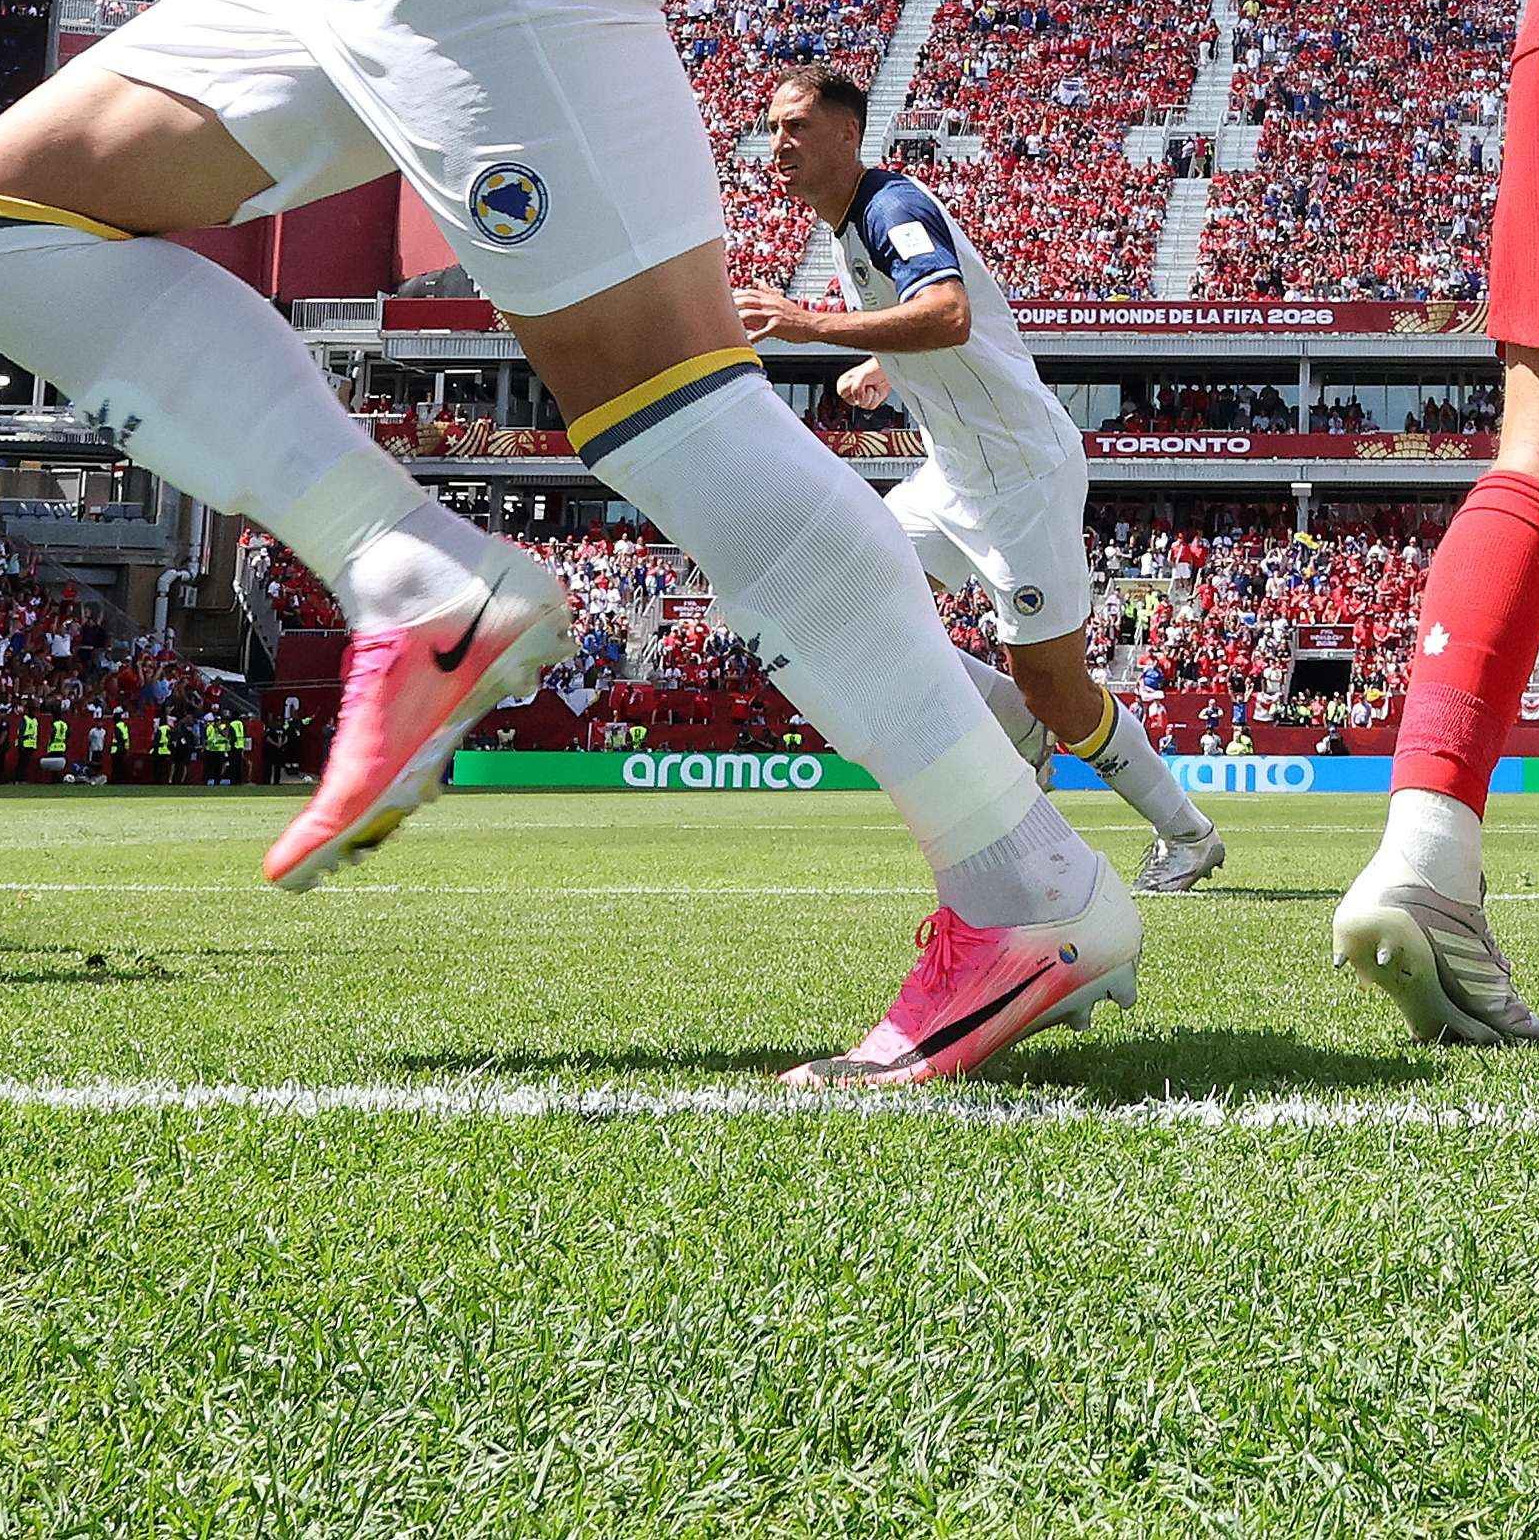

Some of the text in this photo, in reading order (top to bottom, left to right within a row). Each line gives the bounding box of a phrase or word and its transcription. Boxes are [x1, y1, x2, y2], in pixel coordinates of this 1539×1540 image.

[1071, 309, 1097, 324] DU
[1100, 309, 1166, 324] MONDE
[1169, 309, 1193, 324] DE
[1196, 309, 1220, 324] LA
[1223, 309, 1264, 324] FIFA
[1267, 309, 1334, 324] 2026
[1095, 437, 1251, 453] TORONTO
[623, 753, 823, 789] aramco
